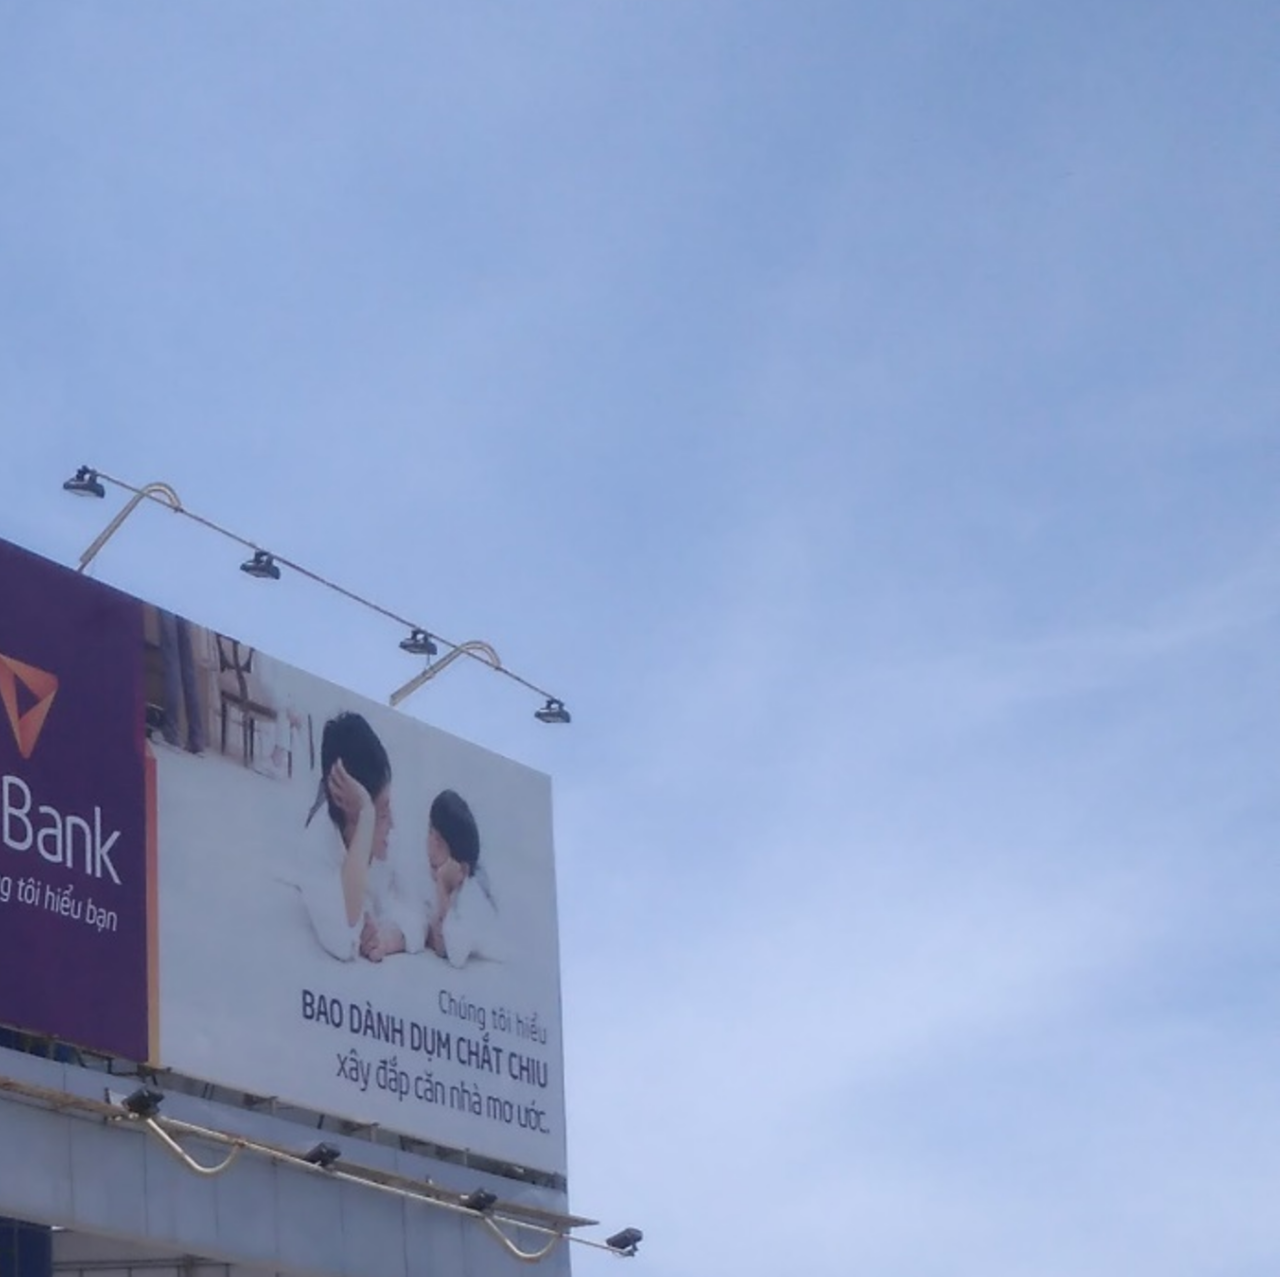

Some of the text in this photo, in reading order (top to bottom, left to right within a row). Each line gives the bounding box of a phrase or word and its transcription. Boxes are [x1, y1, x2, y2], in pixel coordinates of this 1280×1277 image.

[18, 877, 40, 907] tôi
[45, 884, 81, 919] hiểu
[86, 898, 118, 932] bạn
[302, 989, 343, 1028] BAO
[350, 1001, 404, 1048] DÀNH
[411, 1022, 451, 1062] DỤM
[508, 1052, 548, 1089] CHIU
[439, 989, 547, 1046] Chúng tôi hiểu
[376, 1056, 410, 1101] đắp
[414, 1070, 445, 1105] căn
[450, 1081, 482, 1116] nhà
